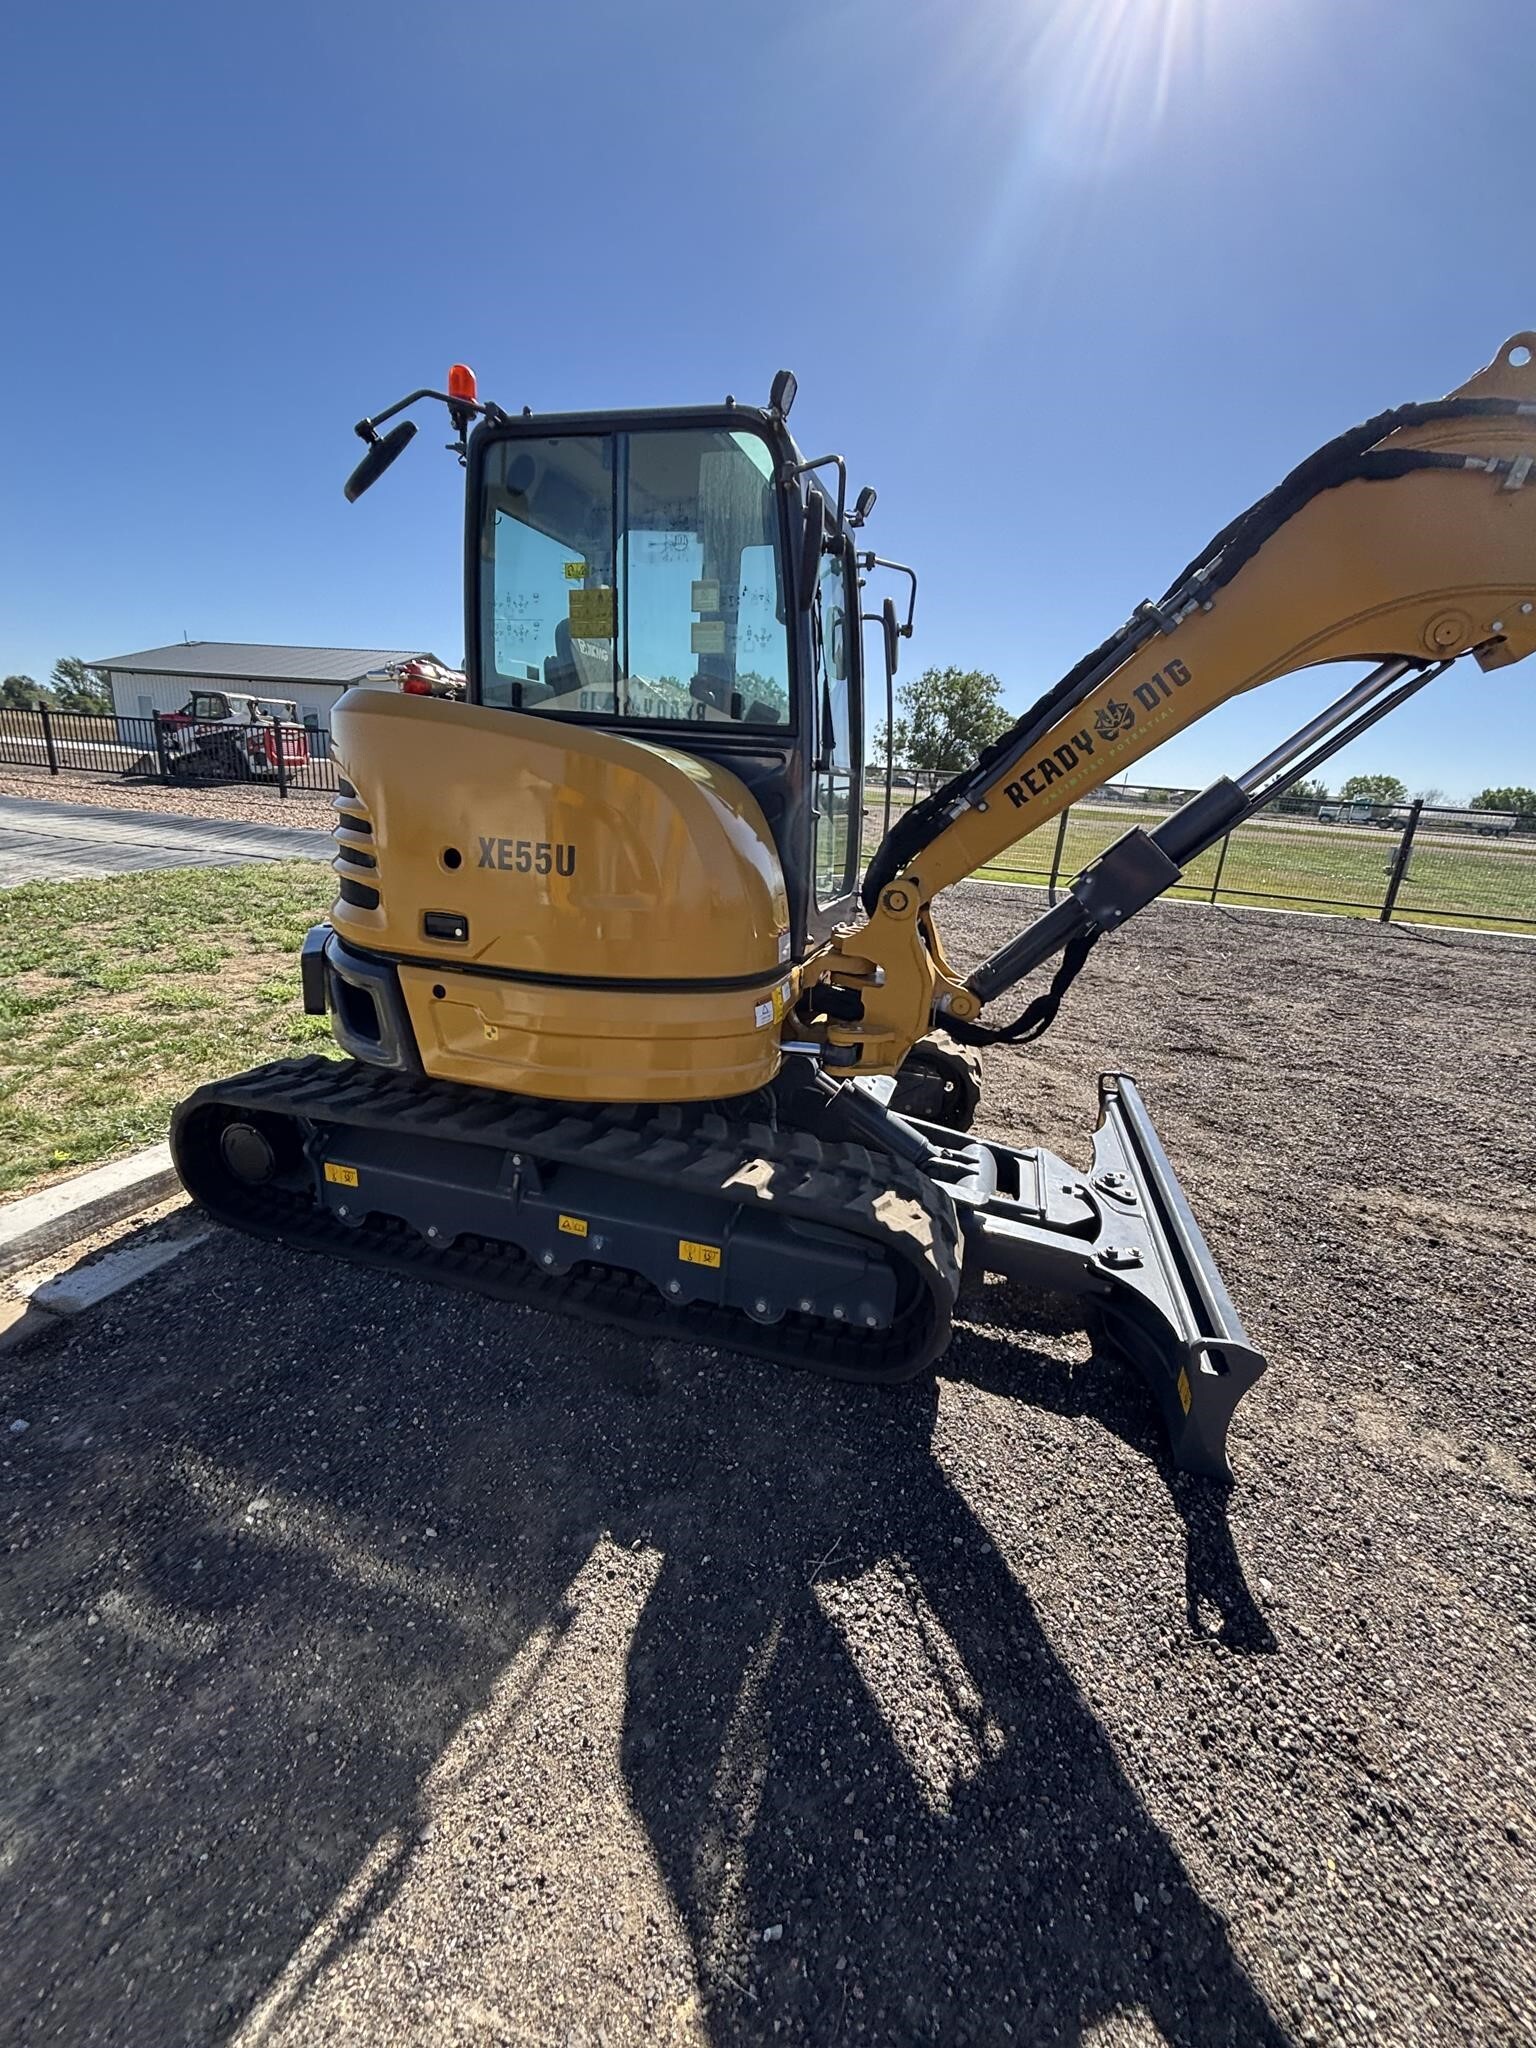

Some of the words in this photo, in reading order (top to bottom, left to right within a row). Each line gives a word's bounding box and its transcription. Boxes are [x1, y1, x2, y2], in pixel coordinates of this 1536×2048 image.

[1109, 706, 1176, 757] POTENTIAL
[1003, 728, 1096, 809] READY
[477, 836, 576, 877] XE55U
